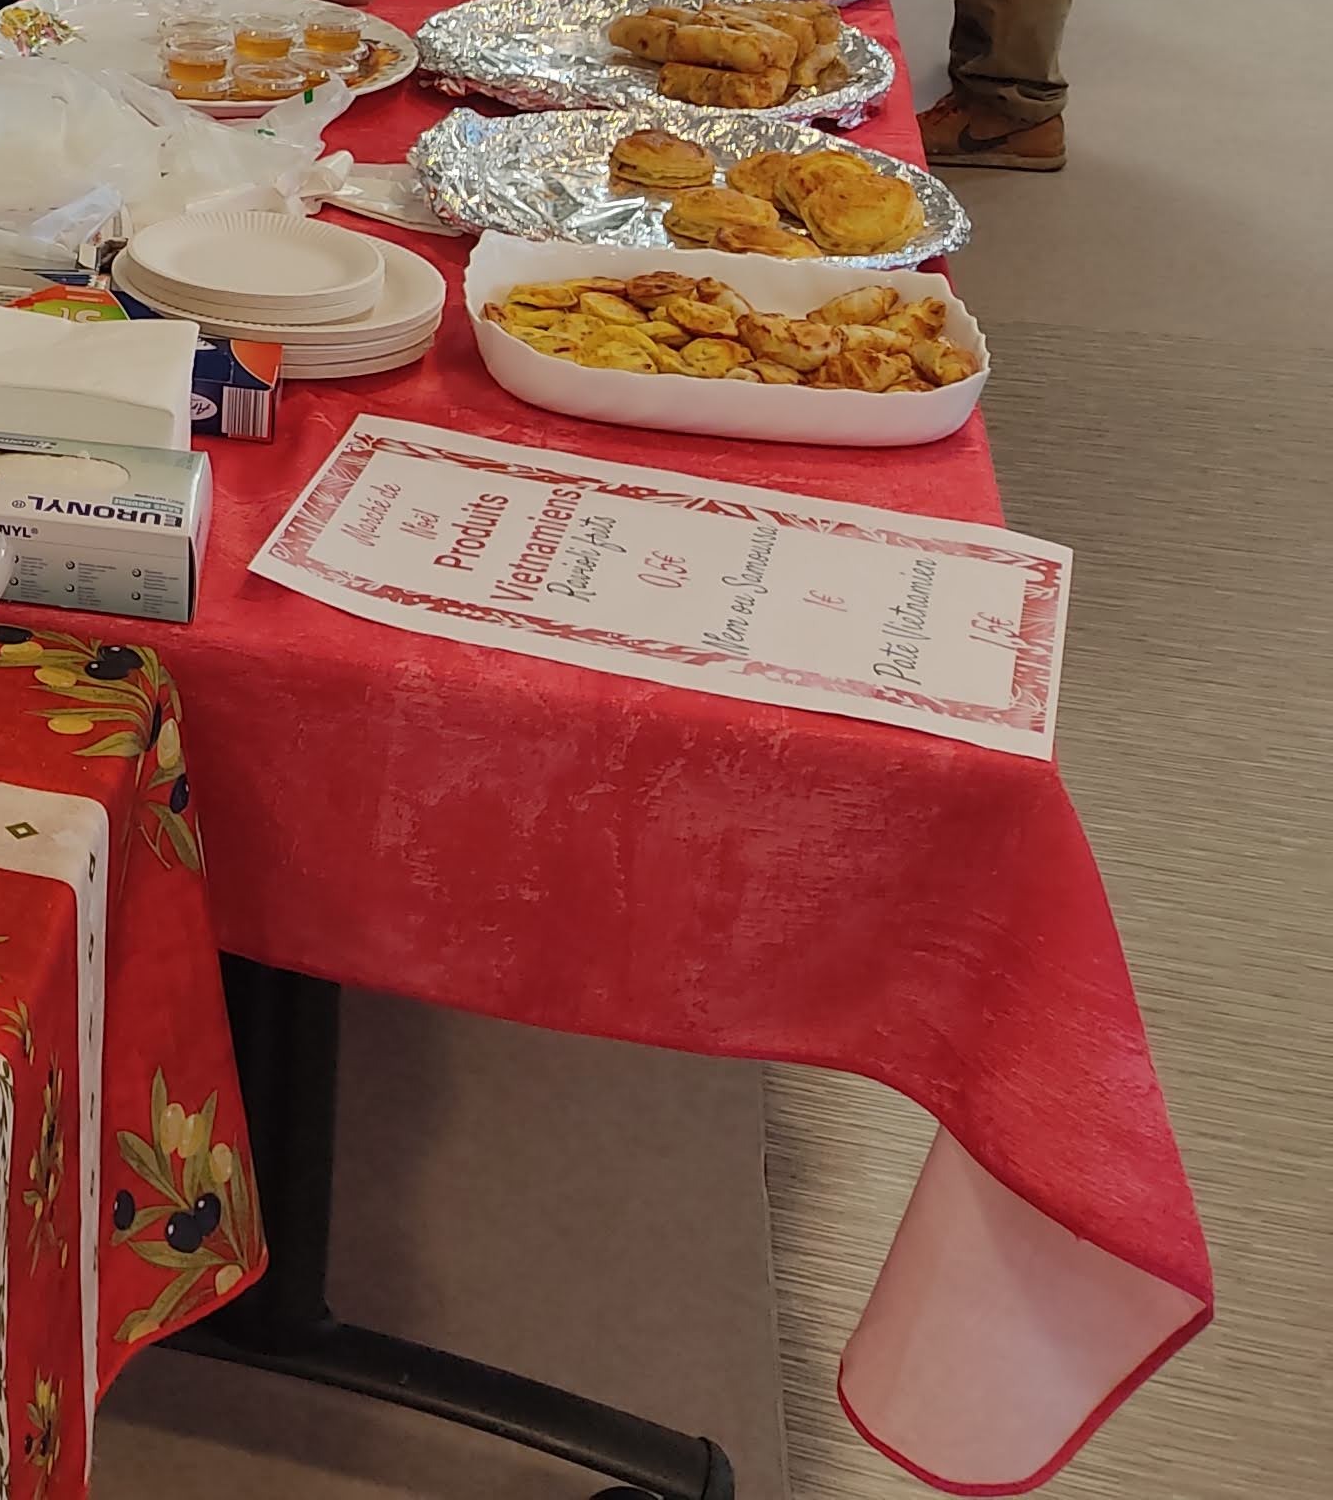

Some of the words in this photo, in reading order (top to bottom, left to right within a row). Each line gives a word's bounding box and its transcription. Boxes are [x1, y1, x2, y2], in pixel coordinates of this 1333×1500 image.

[27, 494, 184, 528] EURONYL
[340, 498, 393, 548] Marché
[375, 482, 401, 500] de
[398, 509, 441, 541] Noël
[433, 492, 509, 572] Produits
[489, 488, 582, 603] Vietnamiens
[570, 515, 626, 553] frits
[546, 547, 600, 603] Ravioli
[637, 552, 688, 591] 0,5€
[721, 523, 779, 595] Samoussa
[729, 594, 755, 616] ou
[802, 589, 848, 613] 1€
[881, 557, 938, 641] Vietnamien
[701, 616, 750, 656] Nem
[968, 611, 1019, 651] 1,5€
